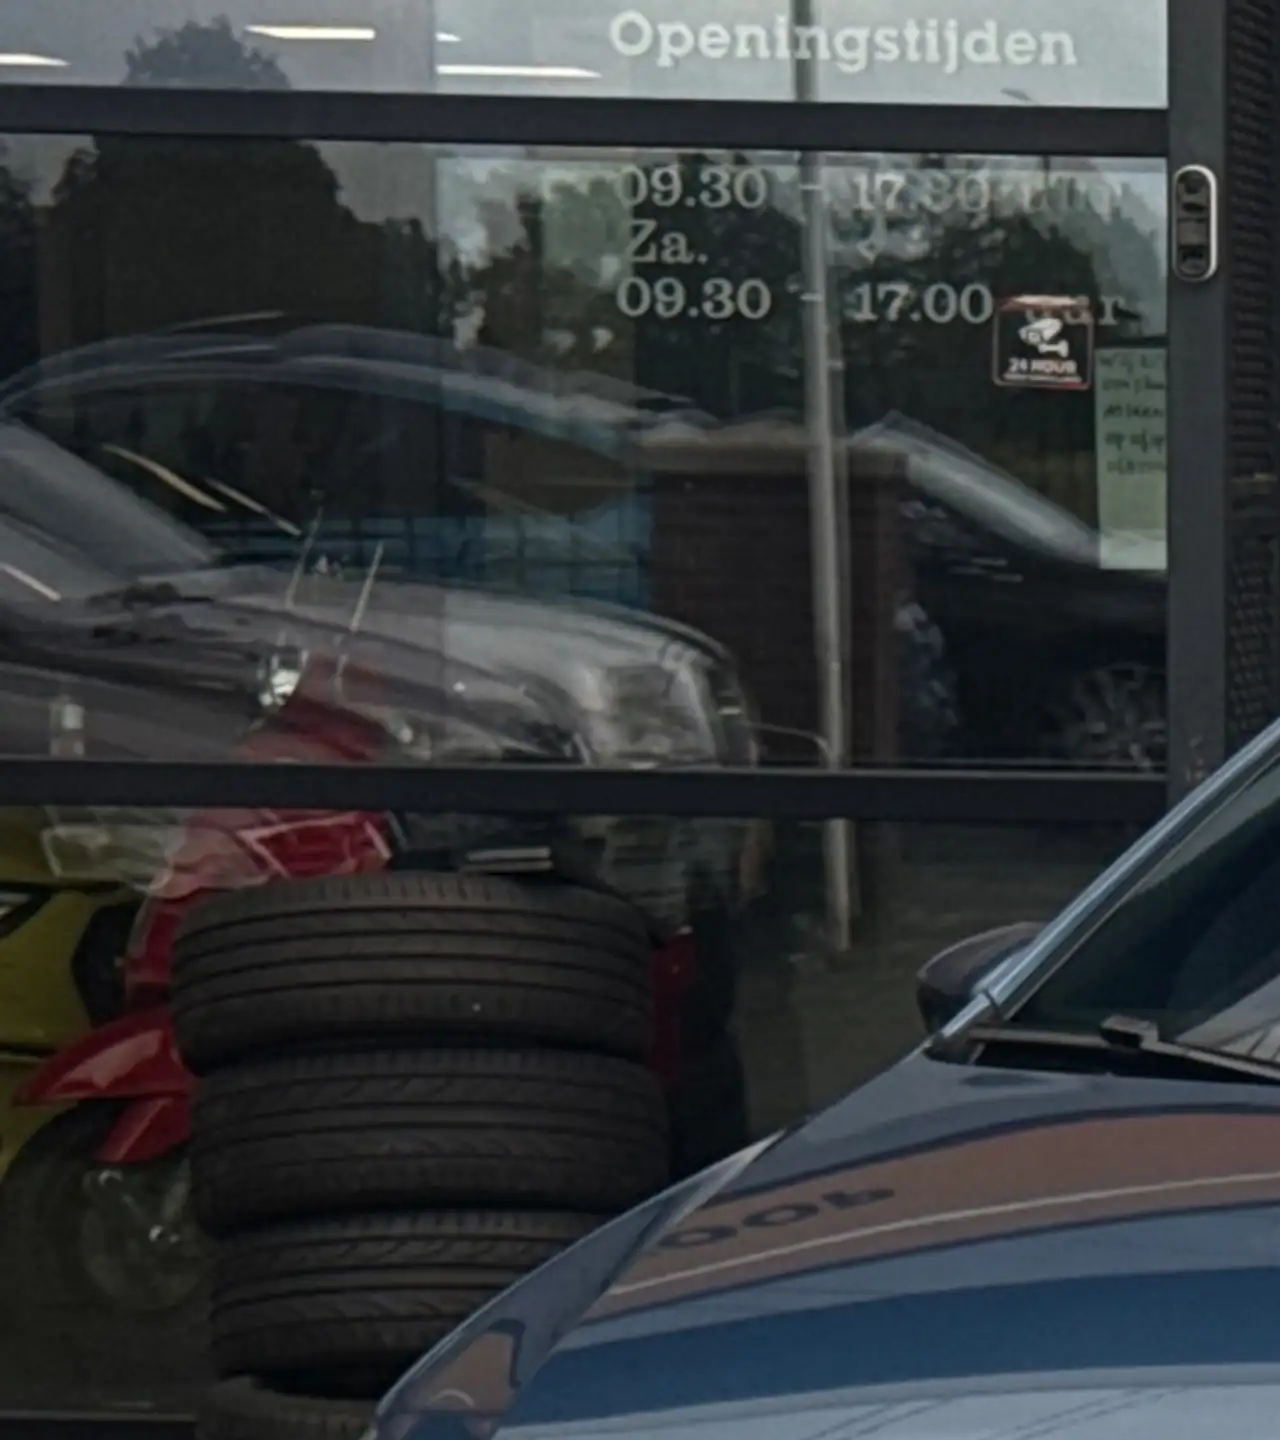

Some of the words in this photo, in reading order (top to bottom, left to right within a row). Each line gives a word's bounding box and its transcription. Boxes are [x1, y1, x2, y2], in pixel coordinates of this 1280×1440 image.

[608, 9, 1078, 75] Openingstijden
[617, 164, 769, 209] 09.30
[626, 218, 707, 265] Za.
[616, 276, 772, 321] 09.30
[850, 282, 994, 325] 17.00
